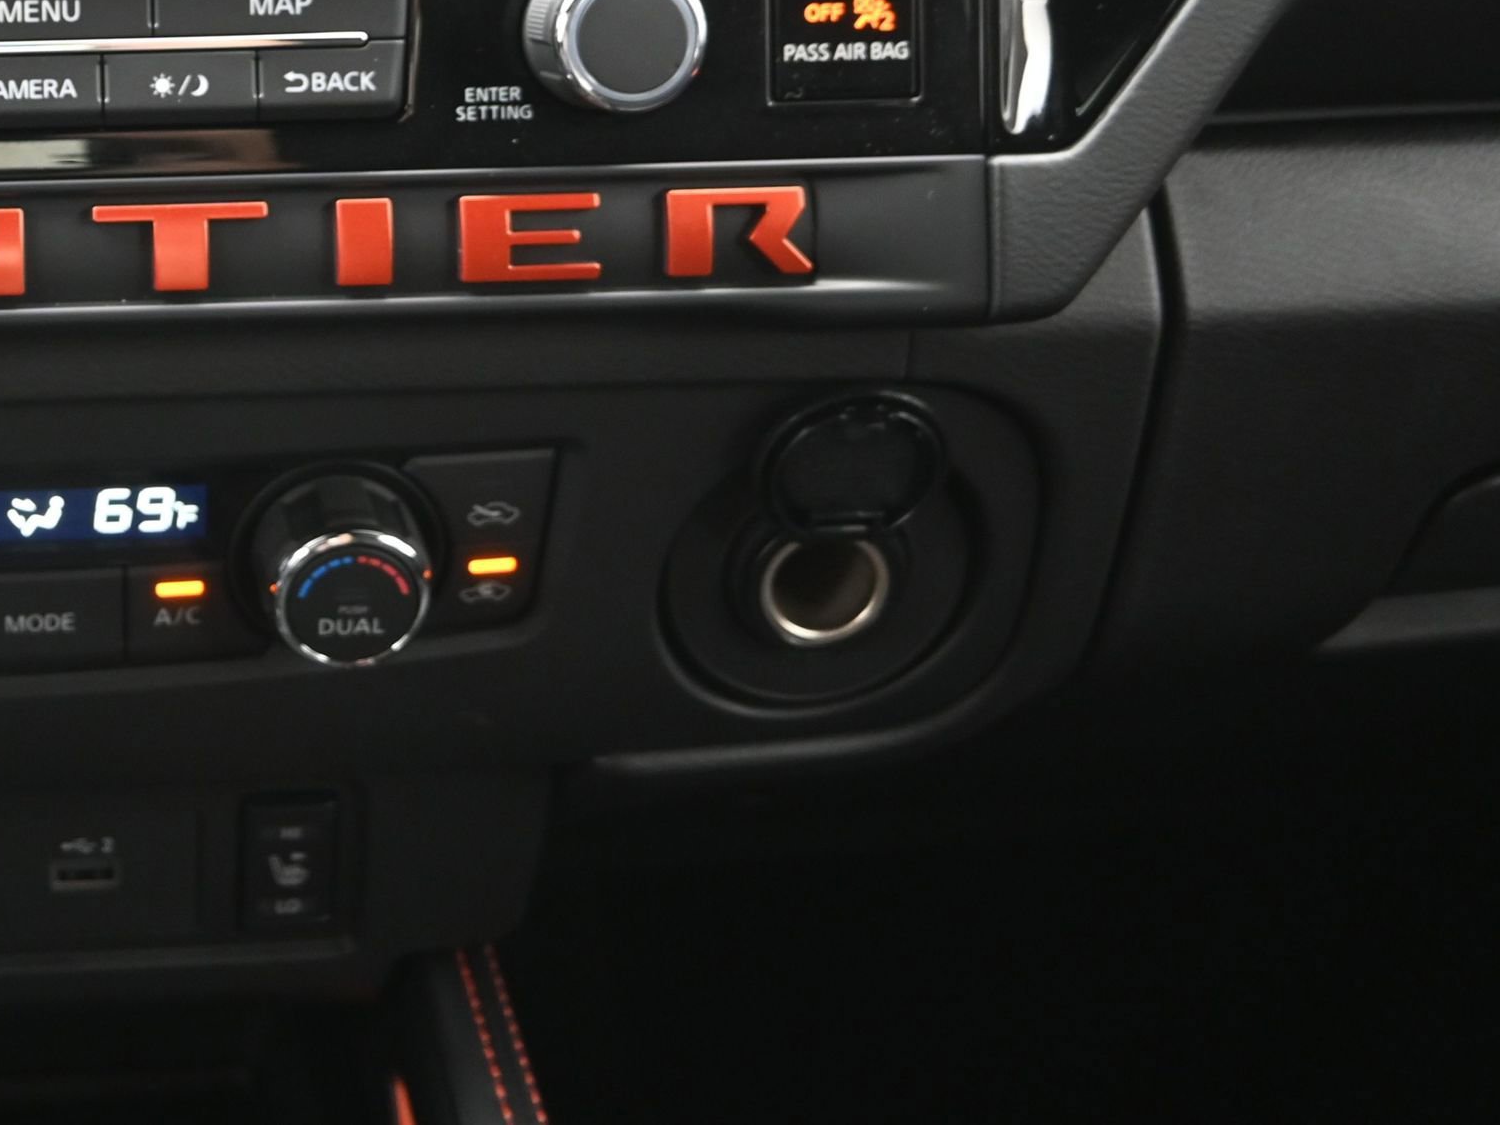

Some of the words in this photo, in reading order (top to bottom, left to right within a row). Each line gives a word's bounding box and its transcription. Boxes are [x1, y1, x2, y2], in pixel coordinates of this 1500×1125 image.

[804, 2, 846, 23] OFF
[783, 43, 830, 62] PASS
[833, 42, 867, 61] AIR
[870, 41, 911, 60] BAG
[311, 71, 376, 93] BACK
[464, 86, 522, 104] ENTER
[455, 103, 534, 121] SETTING
[4, 613, 77, 633] MODE
[153, 607, 202, 626] A/C
[317, 616, 386, 637] DUAL
